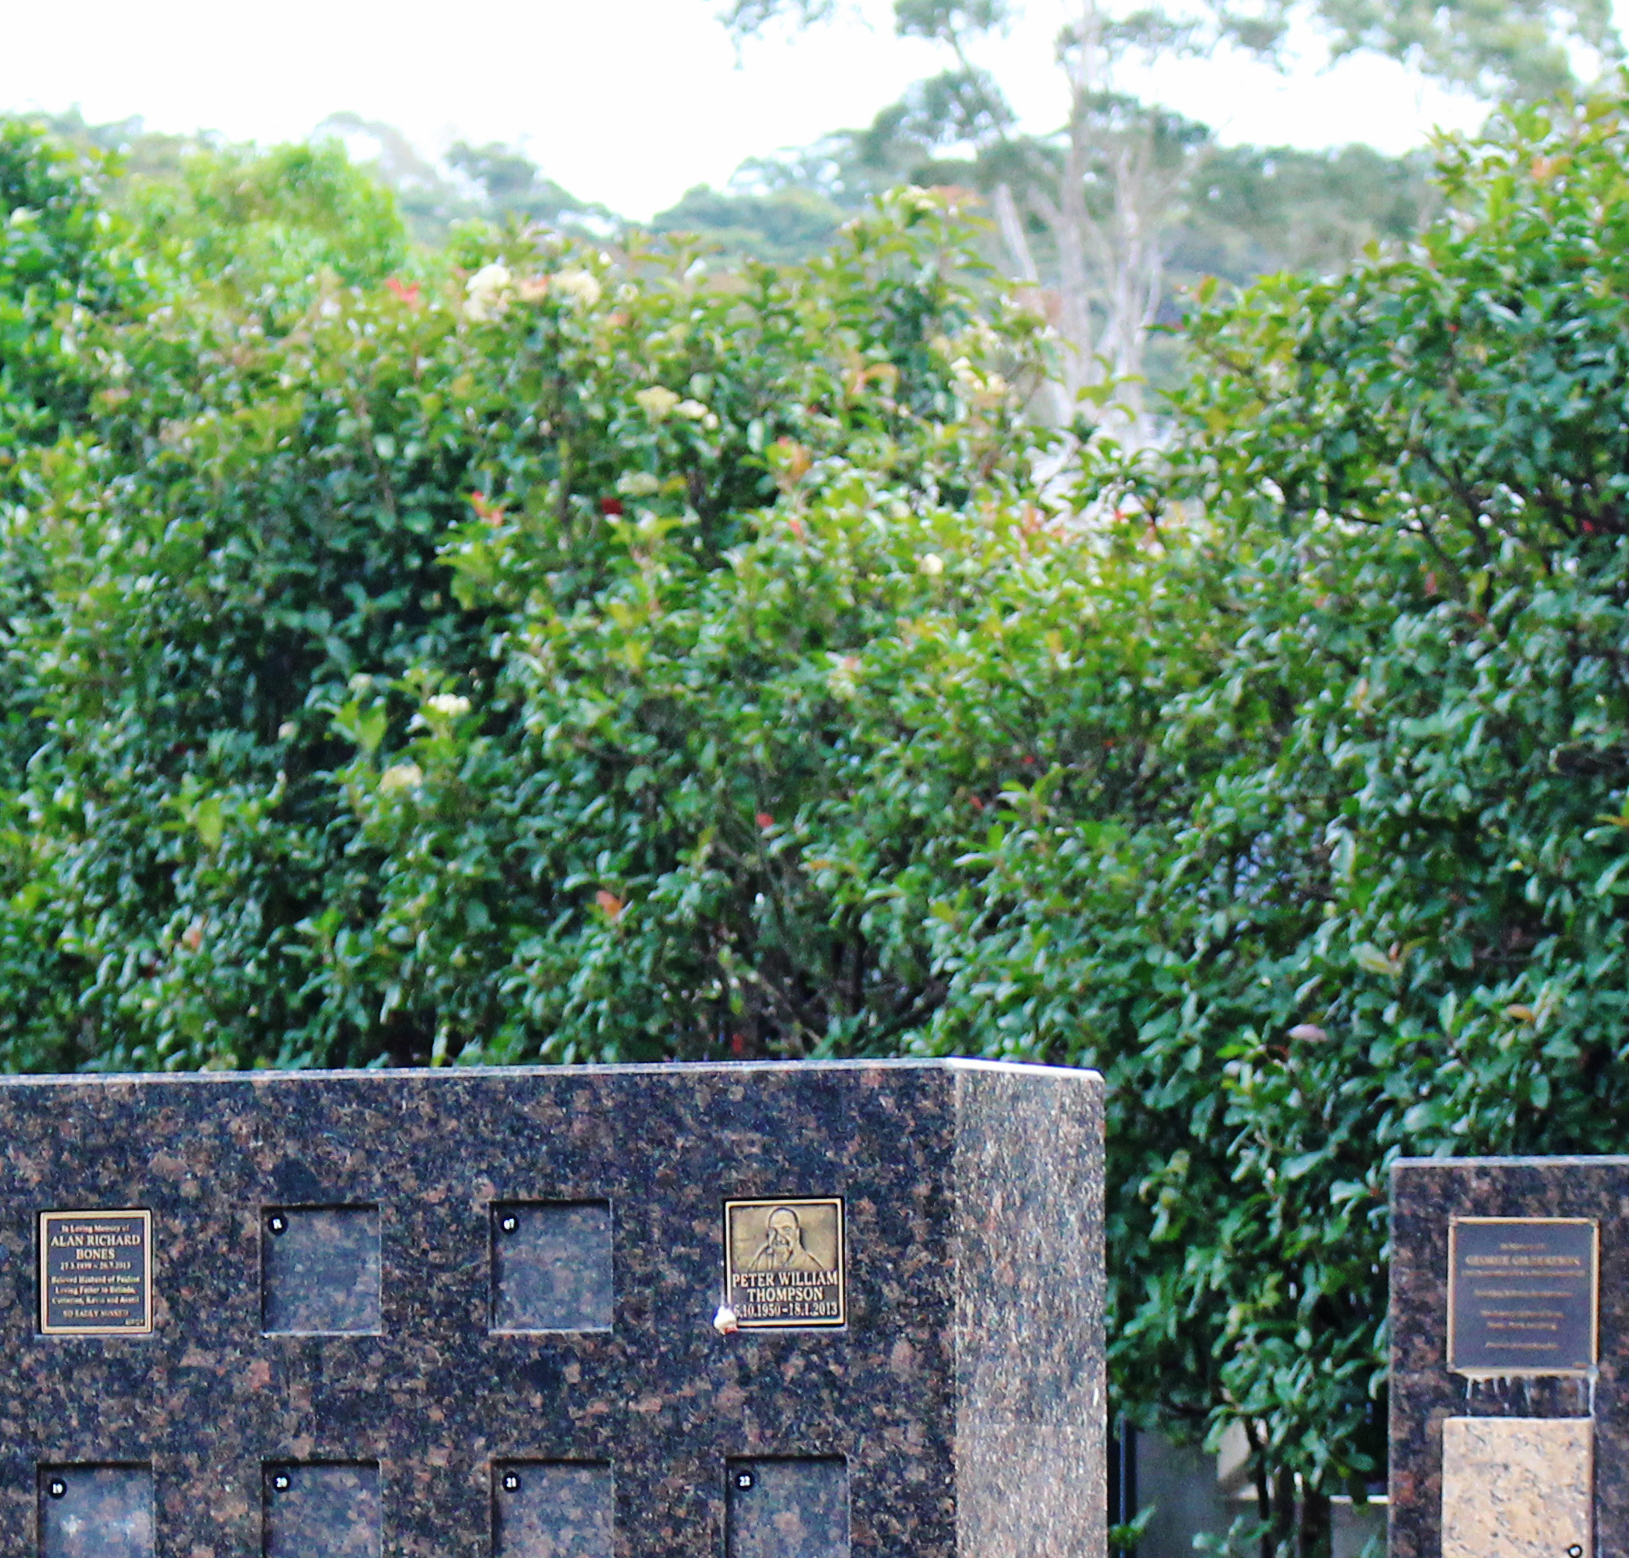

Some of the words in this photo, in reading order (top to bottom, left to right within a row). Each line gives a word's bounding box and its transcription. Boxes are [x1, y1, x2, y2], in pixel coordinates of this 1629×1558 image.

[51, 1235, 84, 1247] ALAN
[87, 1234, 140, 1246] RICHARD
[76, 1248, 116, 1260] BONES
[732, 1272, 774, 1288] PETER
[778, 1270, 838, 1286] WILLIAM
[747, 1287, 824, 1302] THOMPSON
